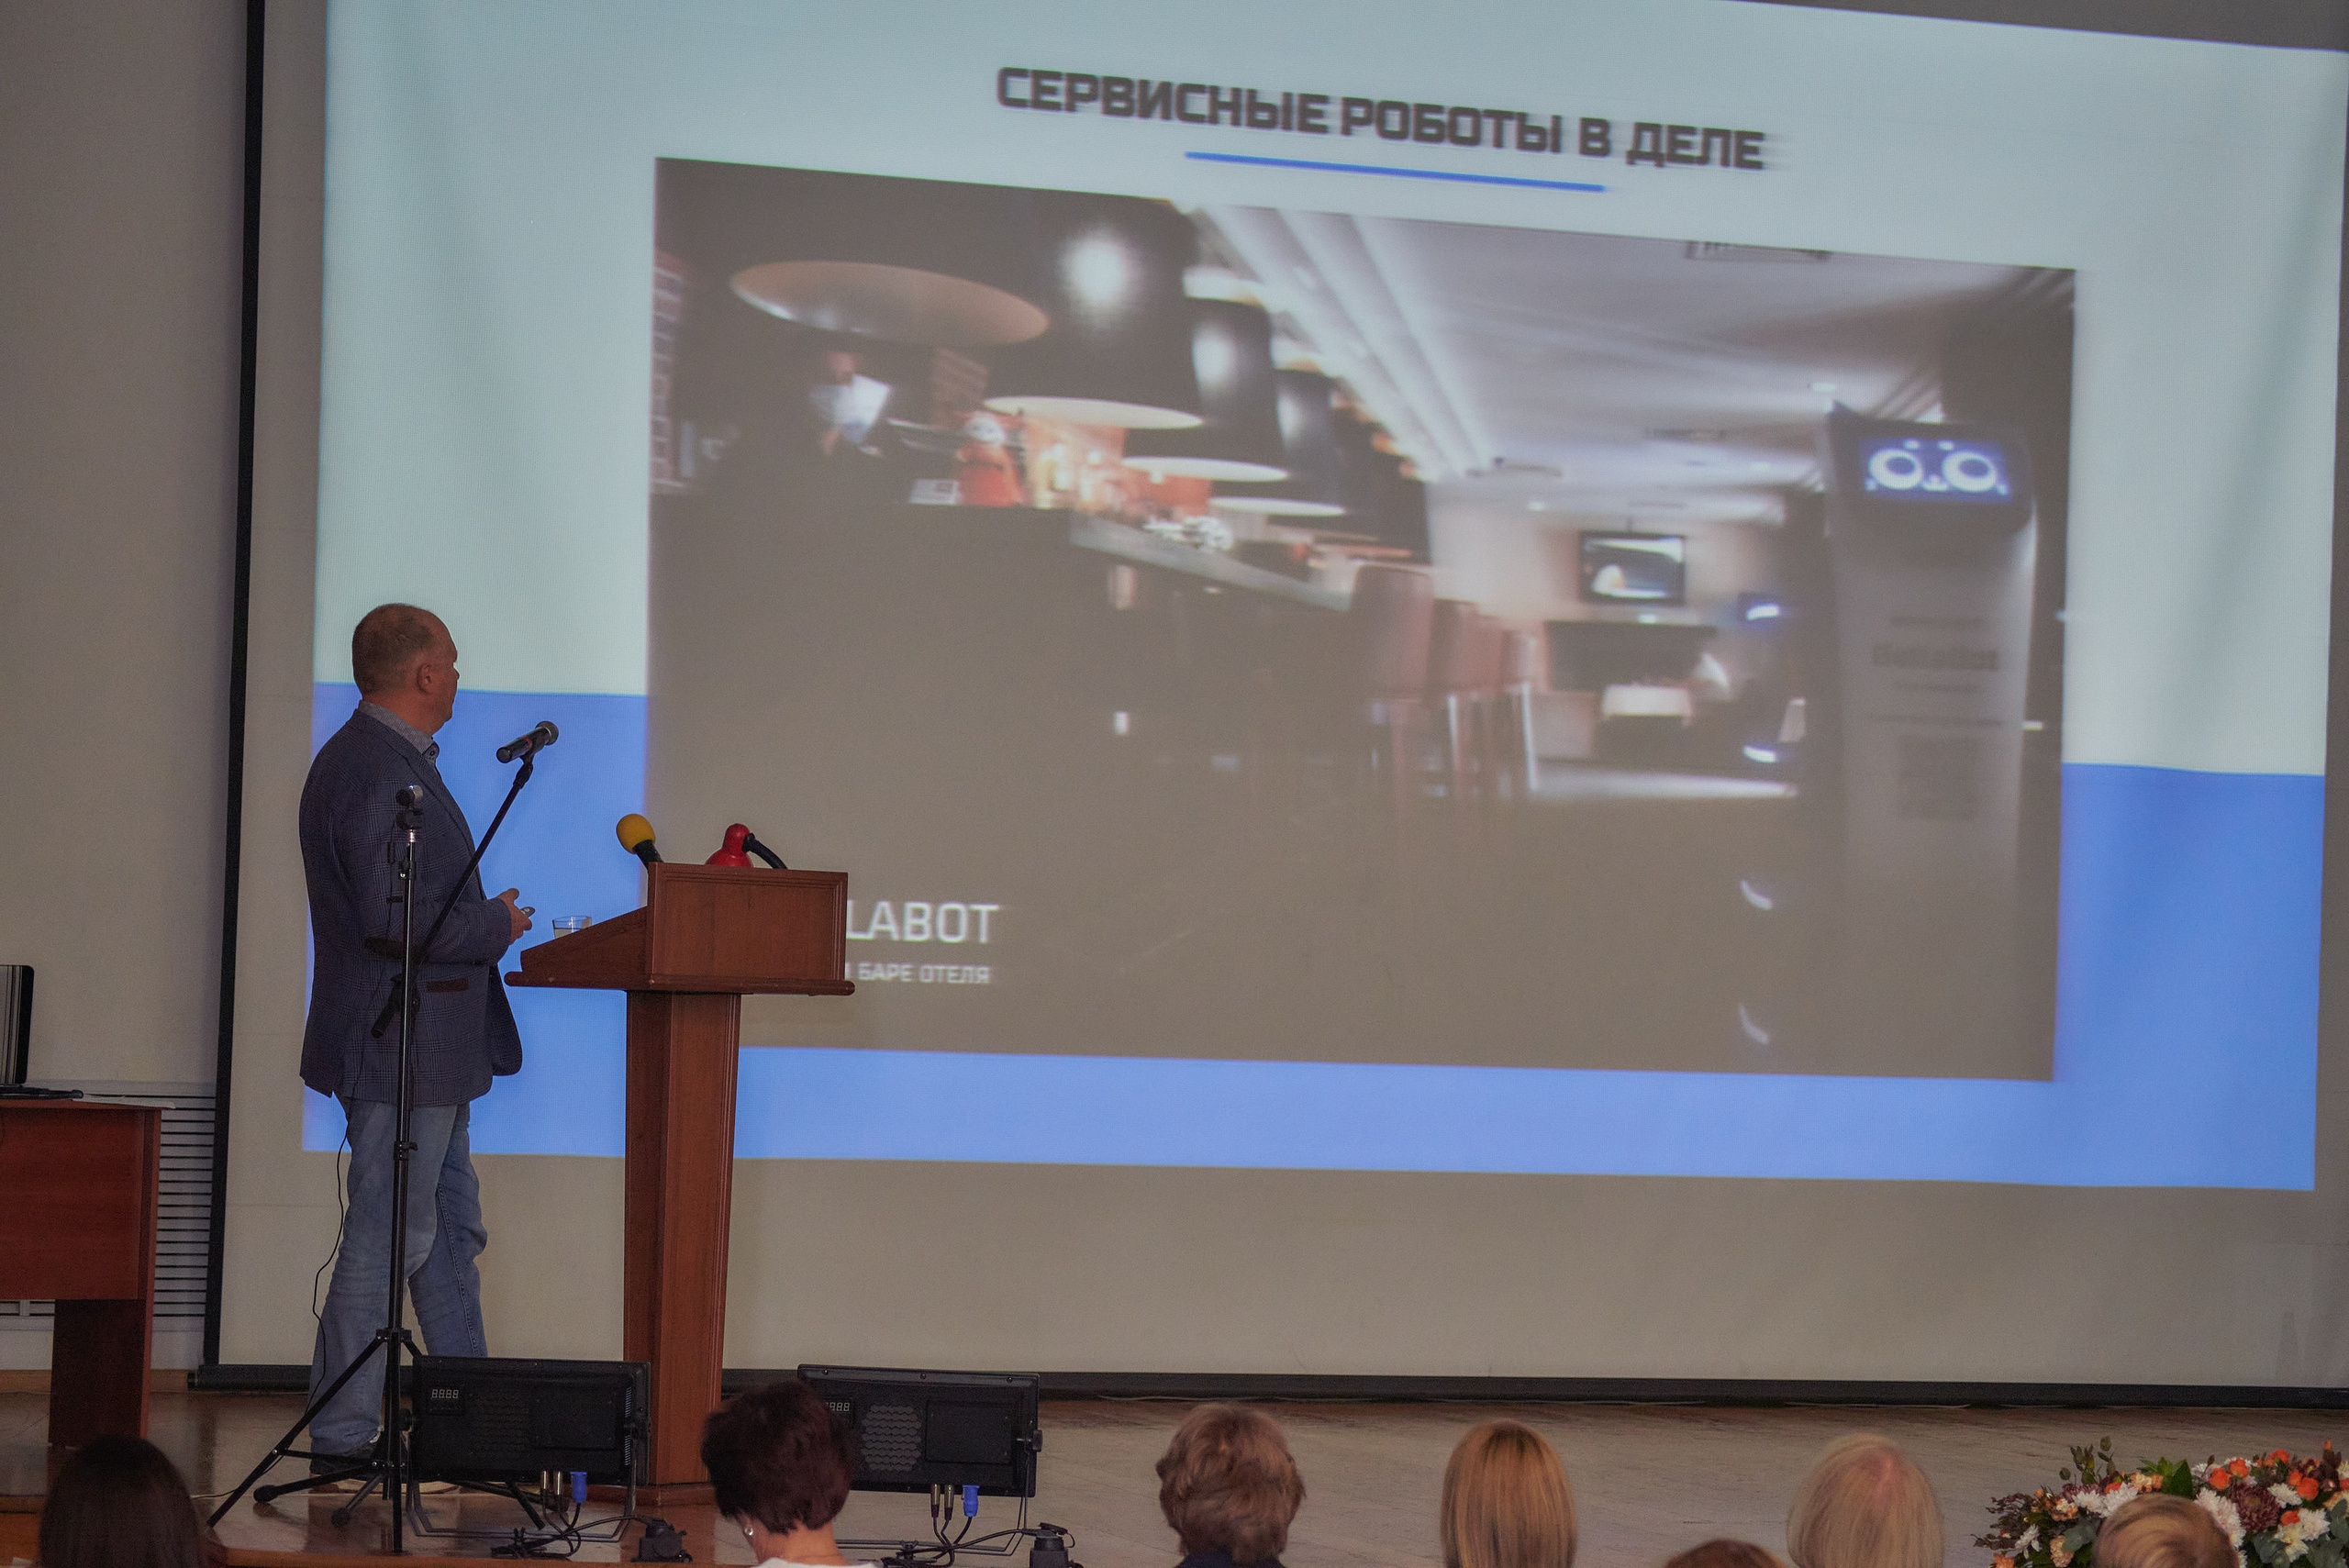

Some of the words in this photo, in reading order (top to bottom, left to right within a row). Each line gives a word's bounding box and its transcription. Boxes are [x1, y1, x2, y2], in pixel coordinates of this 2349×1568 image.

[997, 67, 1330, 134] СЕРВИСНЫЕ
[1341, 96, 1562, 153] РОБОТЫ
[1579, 117, 1611, 158] В
[1626, 121, 1765, 170] ДЕЛЕ
[858, 962, 915, 982] БАРЕ
[919, 965, 990, 984] ОТЕЛЯ
